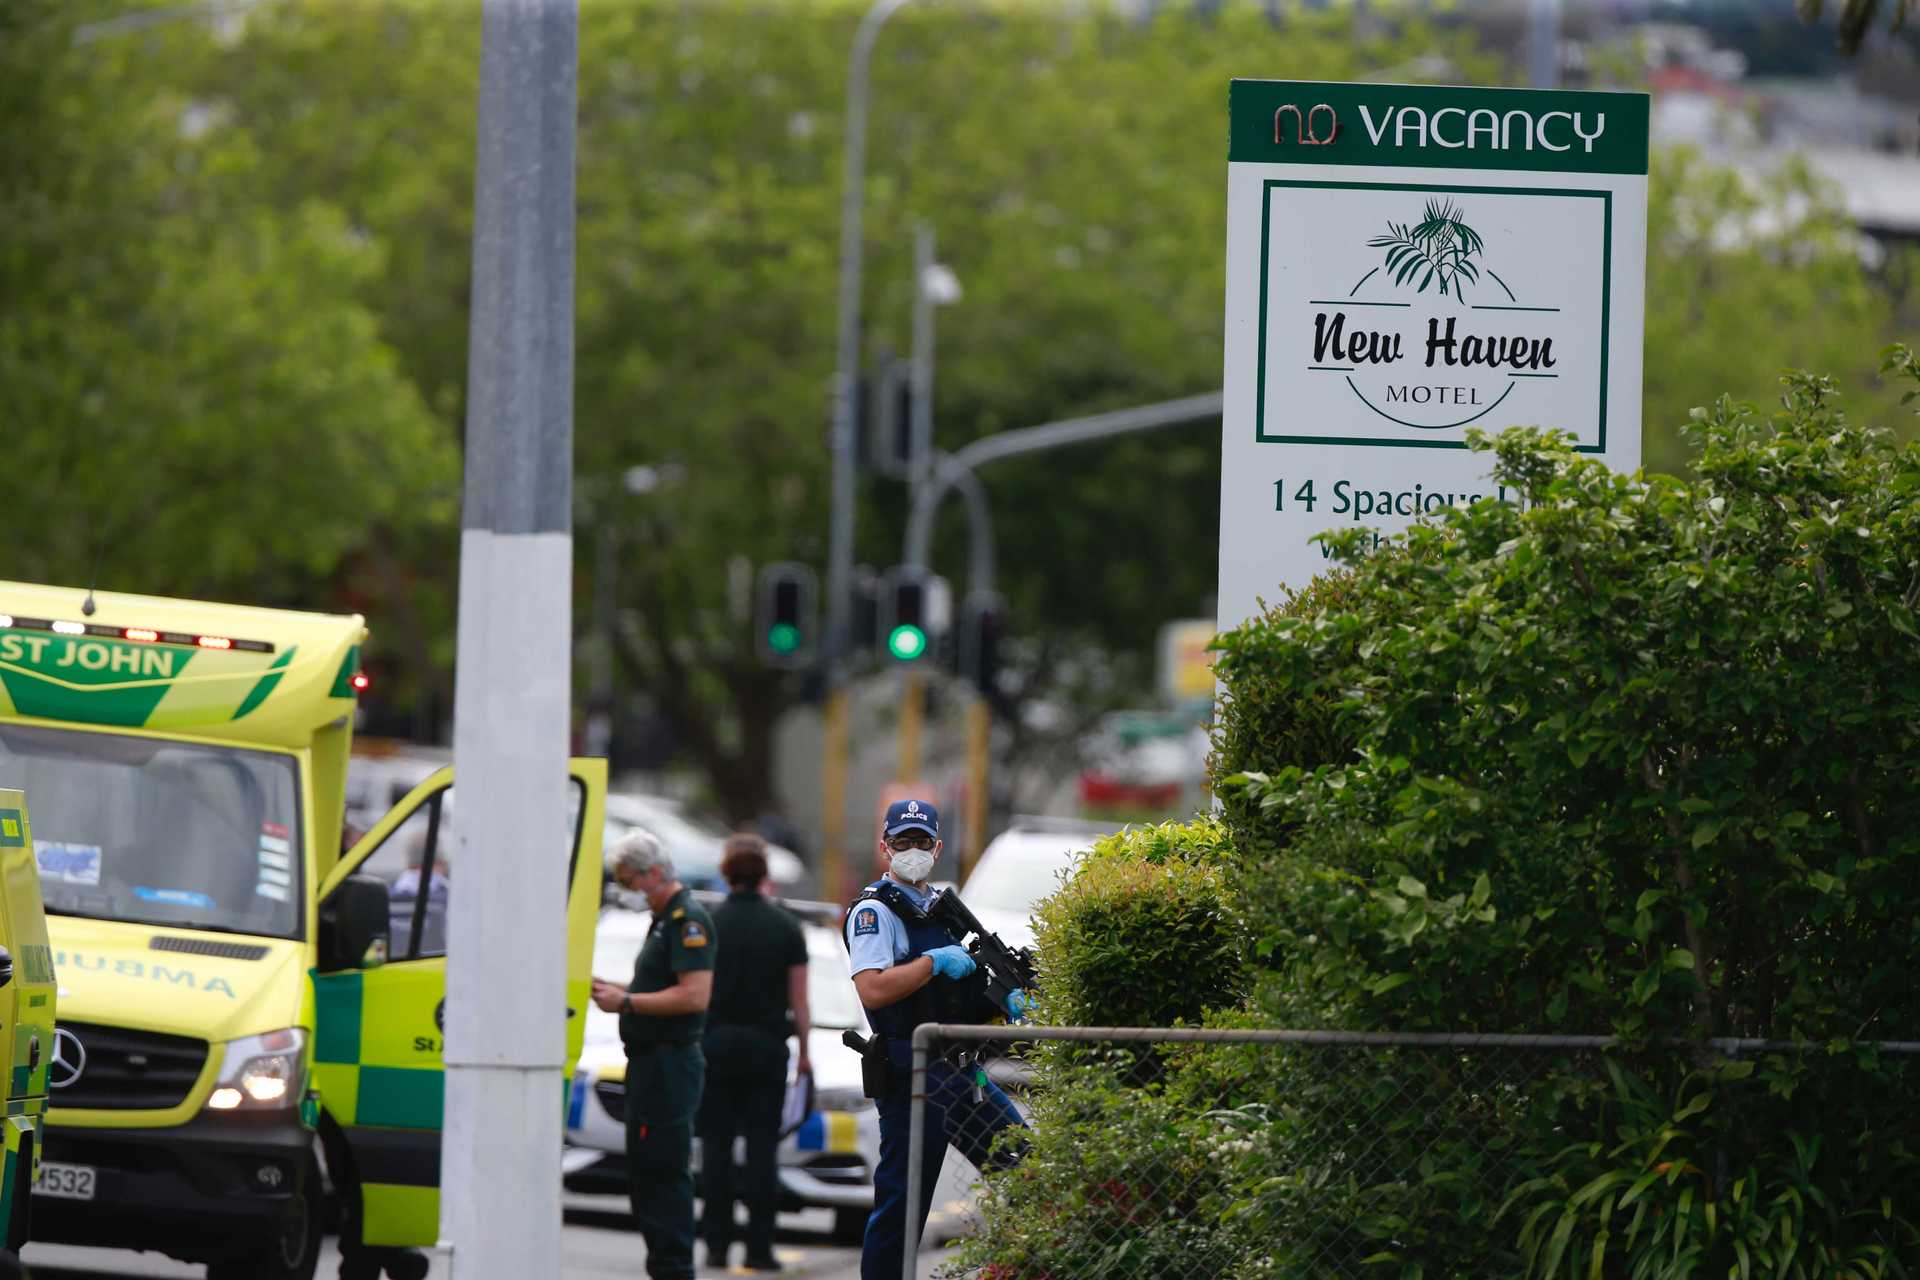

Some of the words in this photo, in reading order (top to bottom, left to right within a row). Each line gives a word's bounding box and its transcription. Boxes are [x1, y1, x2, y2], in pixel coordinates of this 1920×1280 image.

[1358, 104, 1606, 153] VACANCY
[1312, 312, 1404, 364] New
[1423, 317, 1557, 370] Haven
[1386, 385, 1483, 406] MOTEL
[1272, 478, 1318, 512] 14
[0, 634, 49, 664] ST
[56, 640, 174, 677] JOHN
[900, 812, 928, 821] POLICE
